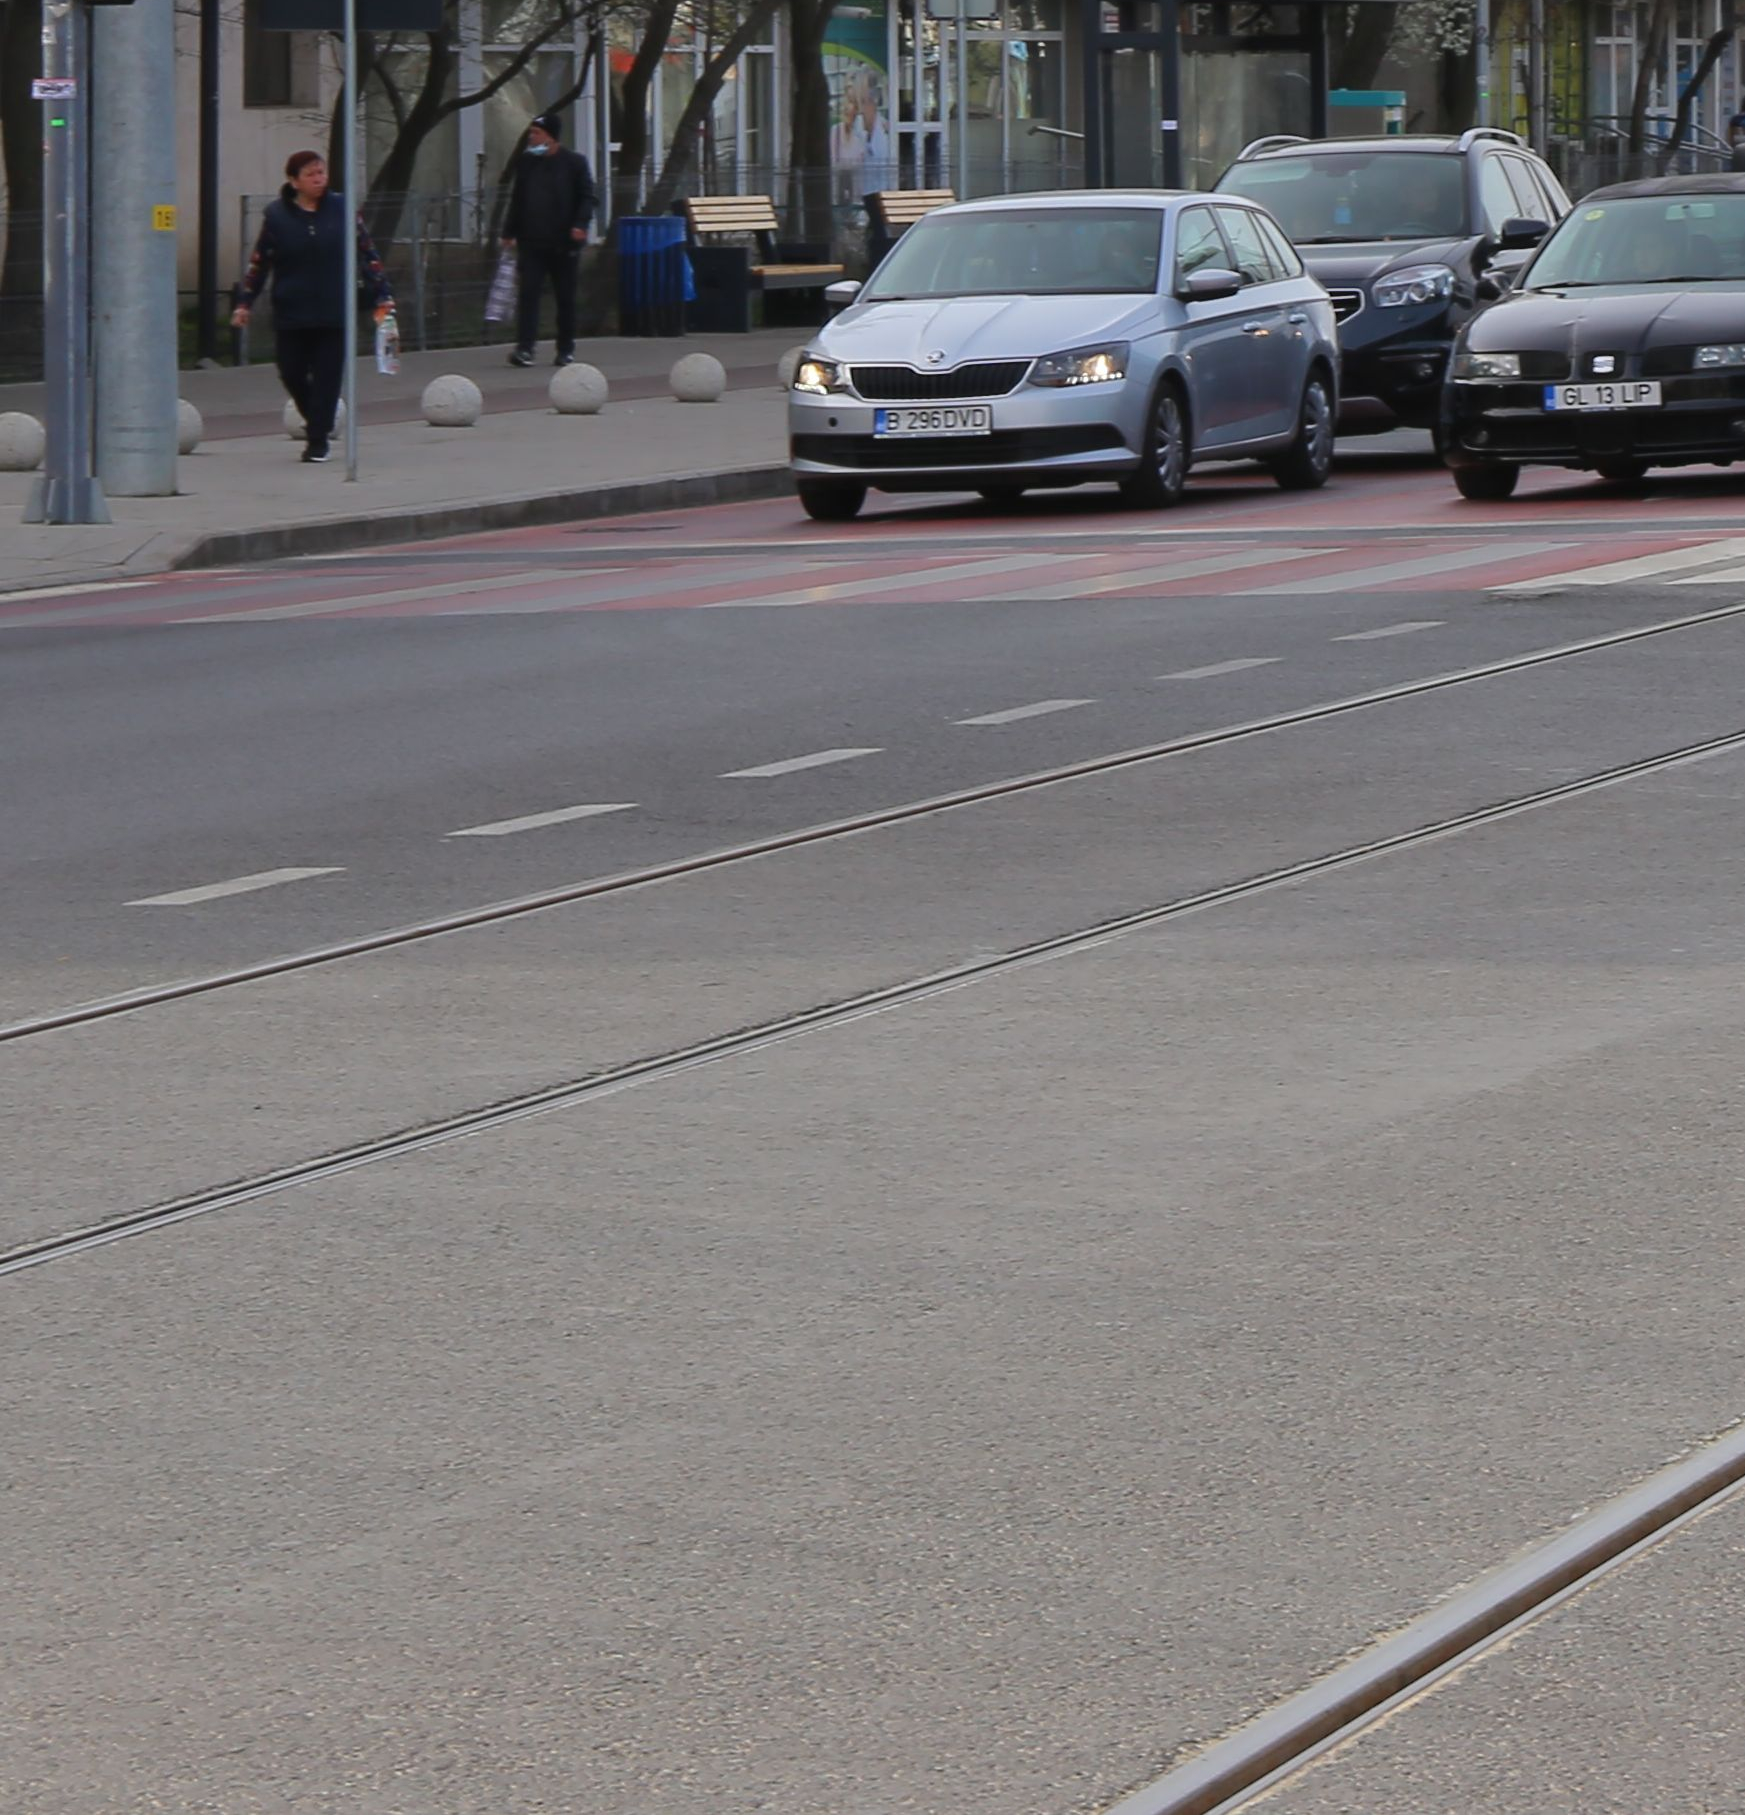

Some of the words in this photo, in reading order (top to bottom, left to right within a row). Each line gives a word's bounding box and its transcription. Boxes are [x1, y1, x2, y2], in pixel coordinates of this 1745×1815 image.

[1564, 387, 1589, 406] GL
[1596, 386, 1614, 404] 13
[1621, 383, 1652, 403] LIP
[887, 412, 900, 430] B
